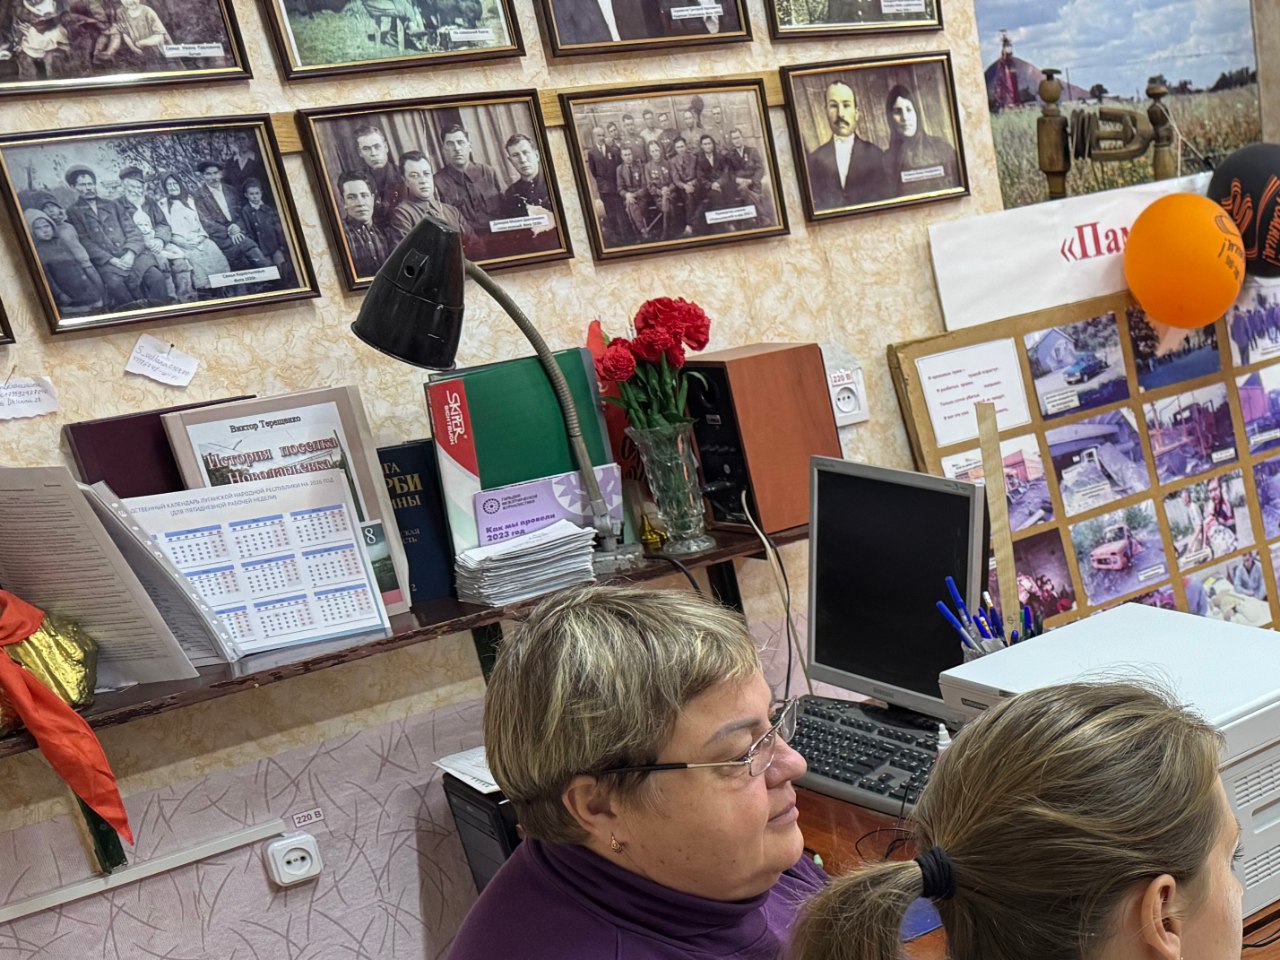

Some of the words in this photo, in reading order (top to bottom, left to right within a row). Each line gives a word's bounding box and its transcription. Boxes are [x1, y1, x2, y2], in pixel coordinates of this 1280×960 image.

[229, 423, 259, 434] Виктор
[259, 414, 302, 431] Терещенко
[446, 390, 465, 445] SKIPER
[206, 448, 273, 470] История
[280, 435, 339, 458] поселка
[485, 525, 504, 534] Как
[504, 521, 519, 529] мы
[520, 513, 556, 527] провели
[364, 527, 376, 544] 8
[486, 531, 510, 542] 2023
[295, 813, 313, 824] 220
